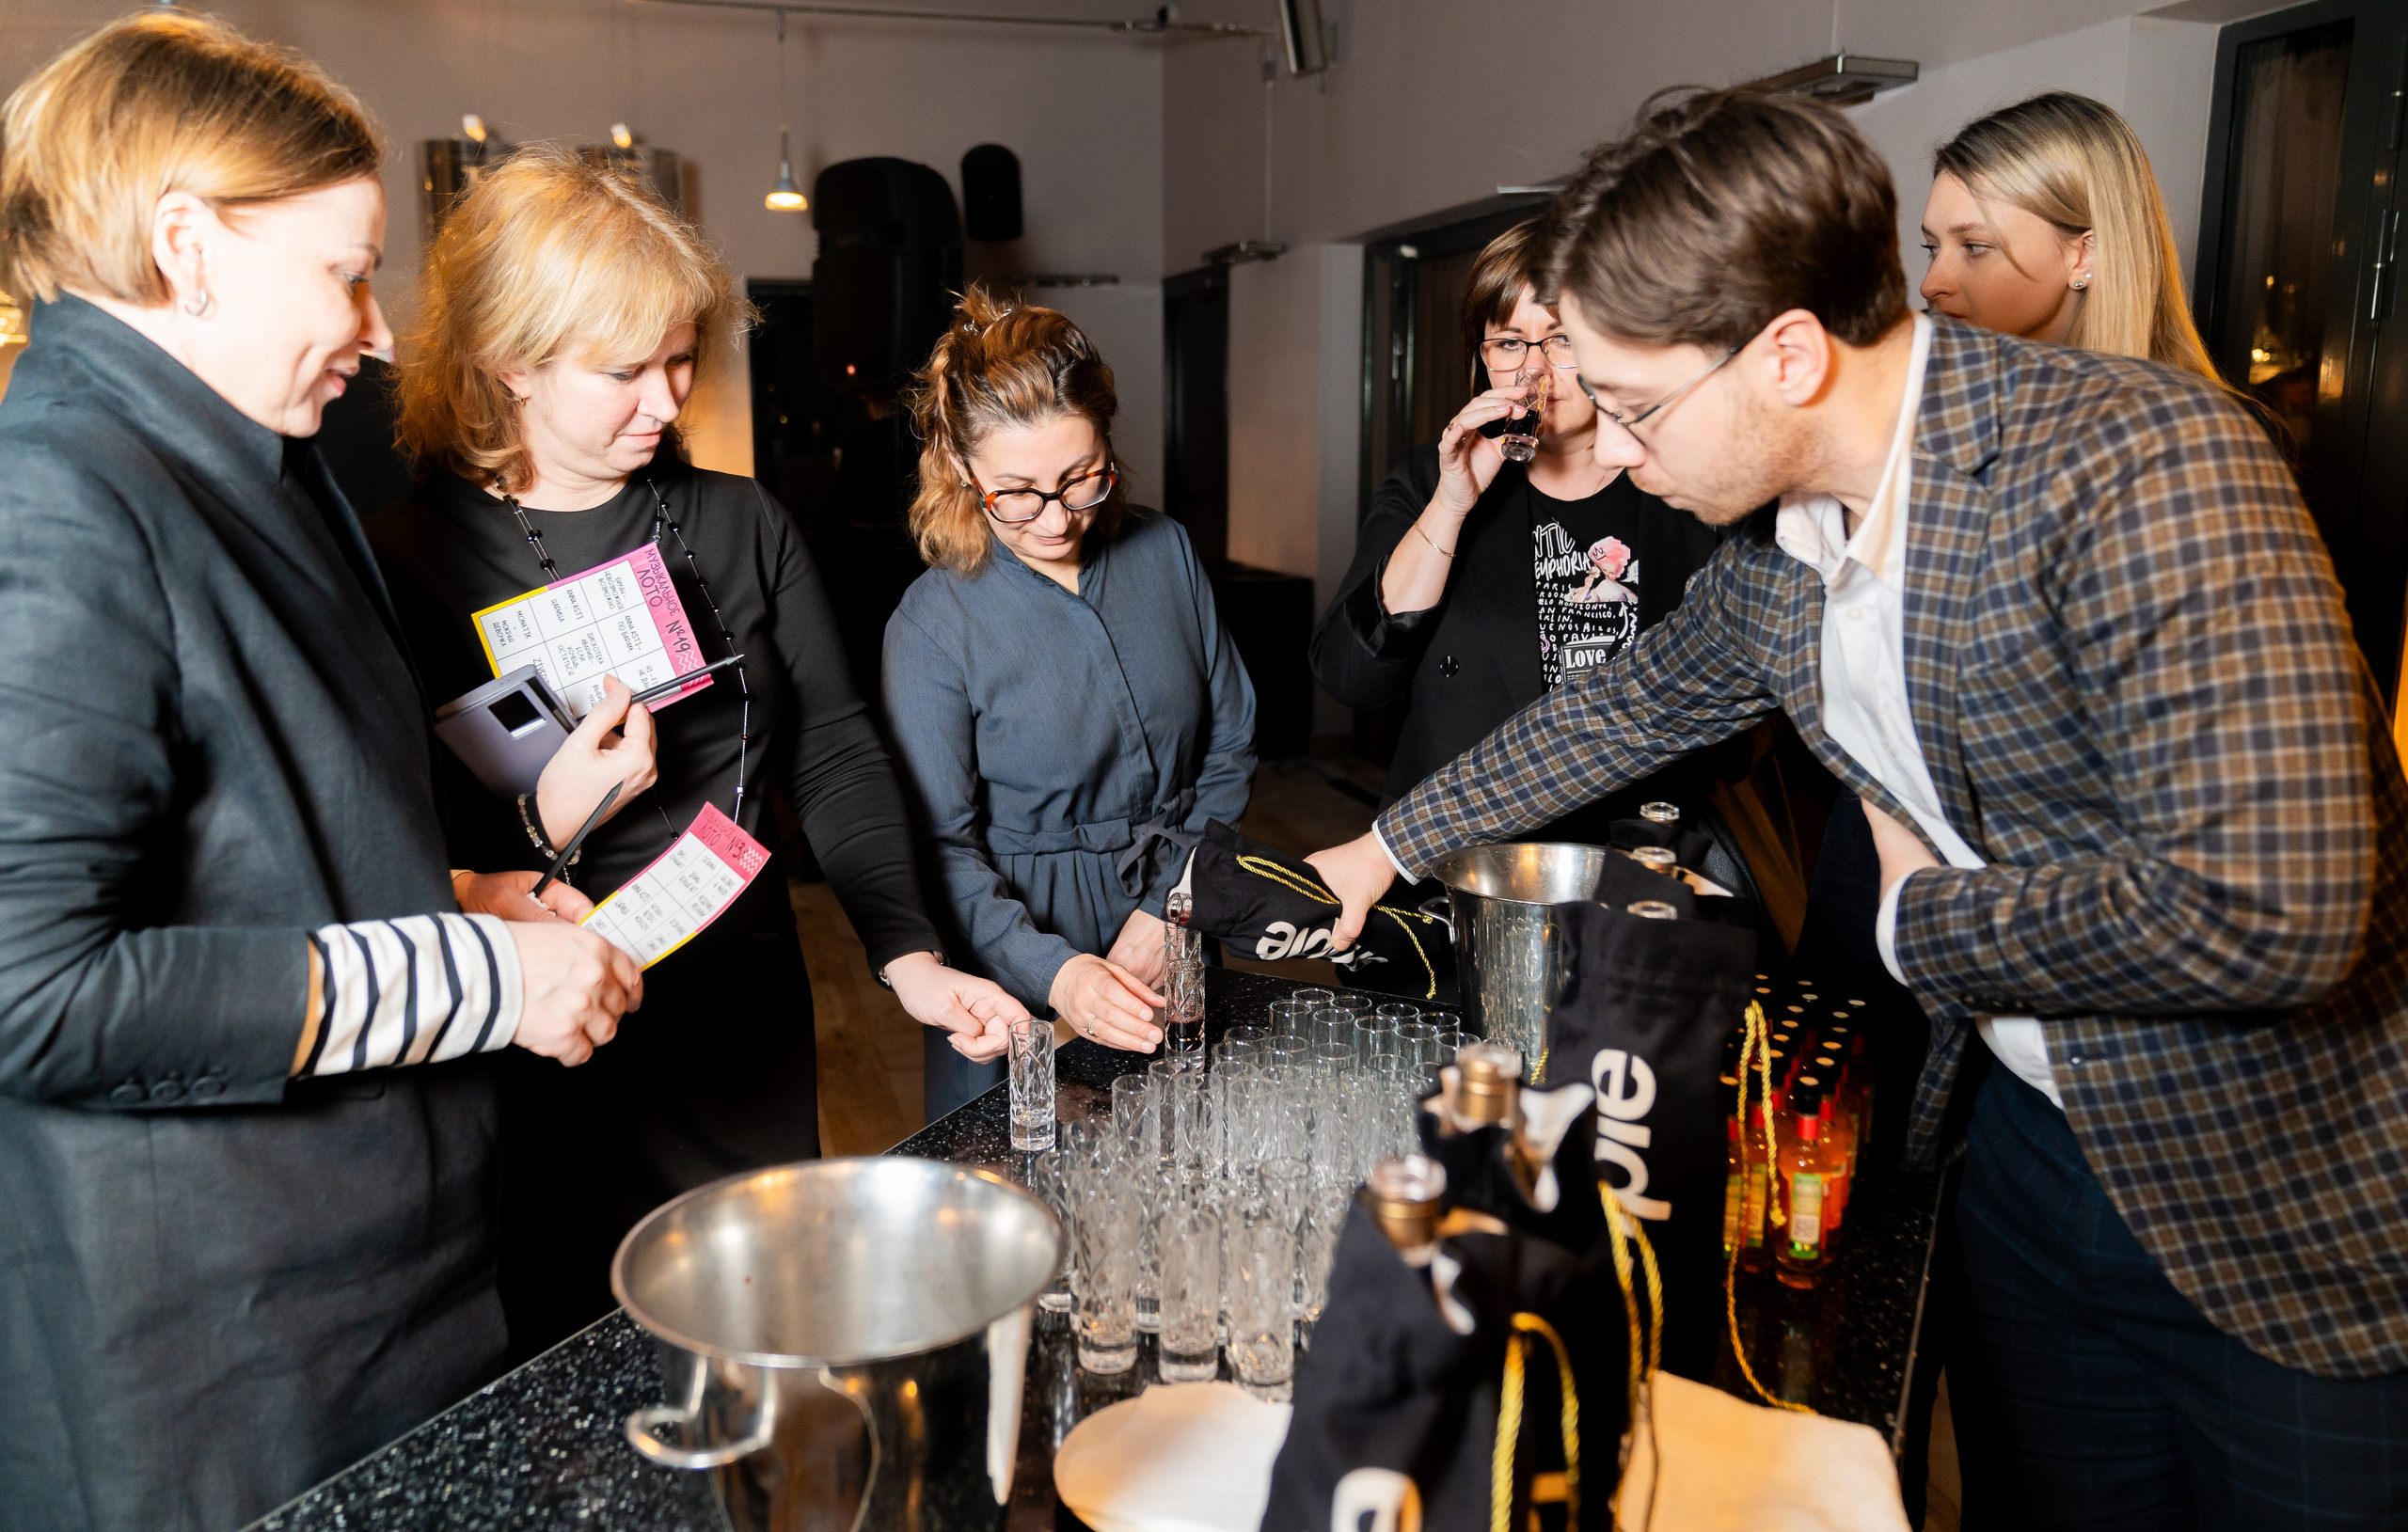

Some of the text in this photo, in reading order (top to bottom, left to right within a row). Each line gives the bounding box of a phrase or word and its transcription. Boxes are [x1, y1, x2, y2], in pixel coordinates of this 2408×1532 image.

[598, 577, 615, 609] ВОЗМОЖНО
[636, 569, 663, 608] ЛОТО
[644, 548, 680, 616] МУЗЫКАЛЬНОЕ
[551, 598, 564, 623] ЦАРИЦА
[1538, 614, 1574, 624] ERLIN,
[492, 622, 507, 647] ДЕВОЧКА
[516, 610, 531, 640] MONATIK
[617, 621, 634, 652] ПО БАРАМ
[1539, 623, 1579, 631] UENOS
[557, 644, 574, 676] ОСТАТЬСЯ
[566, 645, 578, 669] ХОЧЕШЬ
[576, 646, 585, 661] ЕСЛИ
[581, 639, 594, 659] АВАРИЯ
[586, 632, 604, 665] ДИСКОТЕКА
[697, 823, 721, 846] ЛОТО
